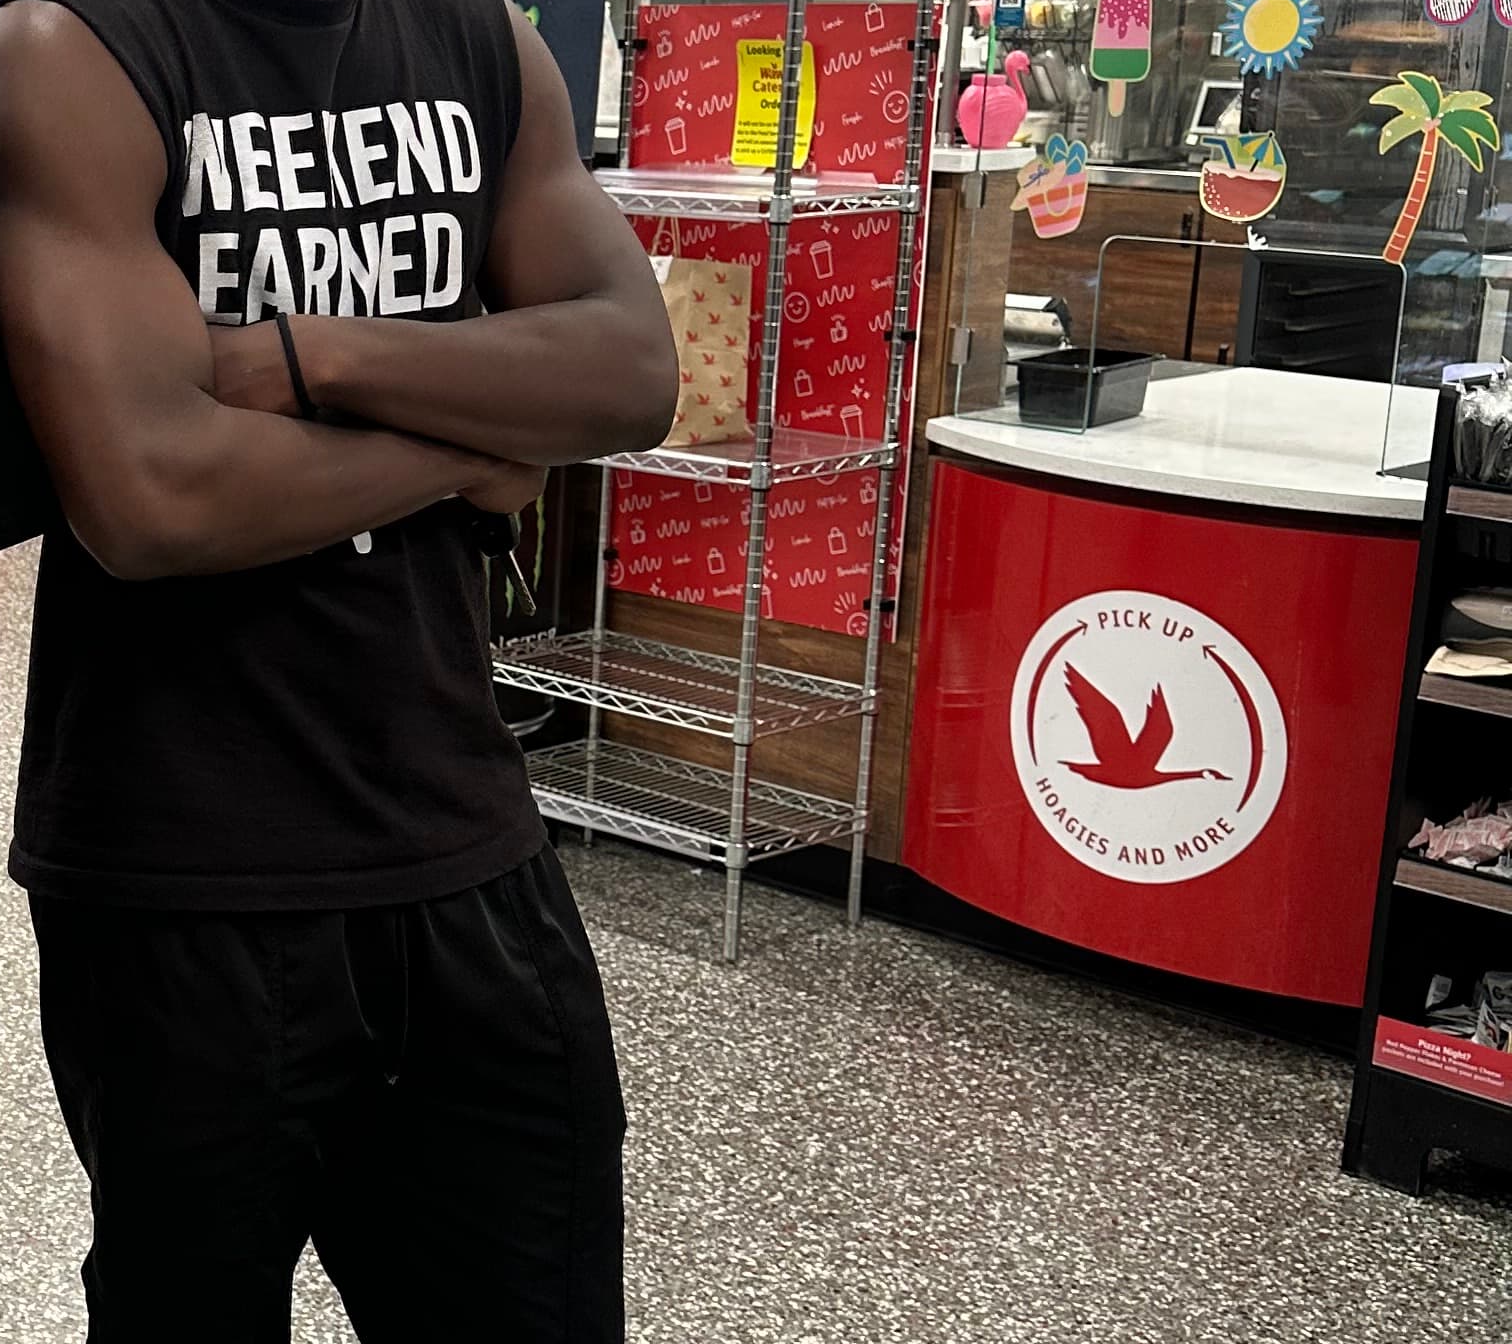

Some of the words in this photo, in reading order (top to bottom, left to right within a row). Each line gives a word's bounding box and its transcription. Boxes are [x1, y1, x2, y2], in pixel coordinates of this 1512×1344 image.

[746, 44, 782, 58] Looking
[181, 100, 482, 218] WEEKEND
[198, 212, 464, 327] EARNED
[1097, 609, 1152, 631] PICK
[1162, 617, 1194, 642] UP
[1036, 777, 1109, 855] HOAGIES
[1117, 845, 1165, 865] AND
[1174, 817, 1235, 861] MORE
